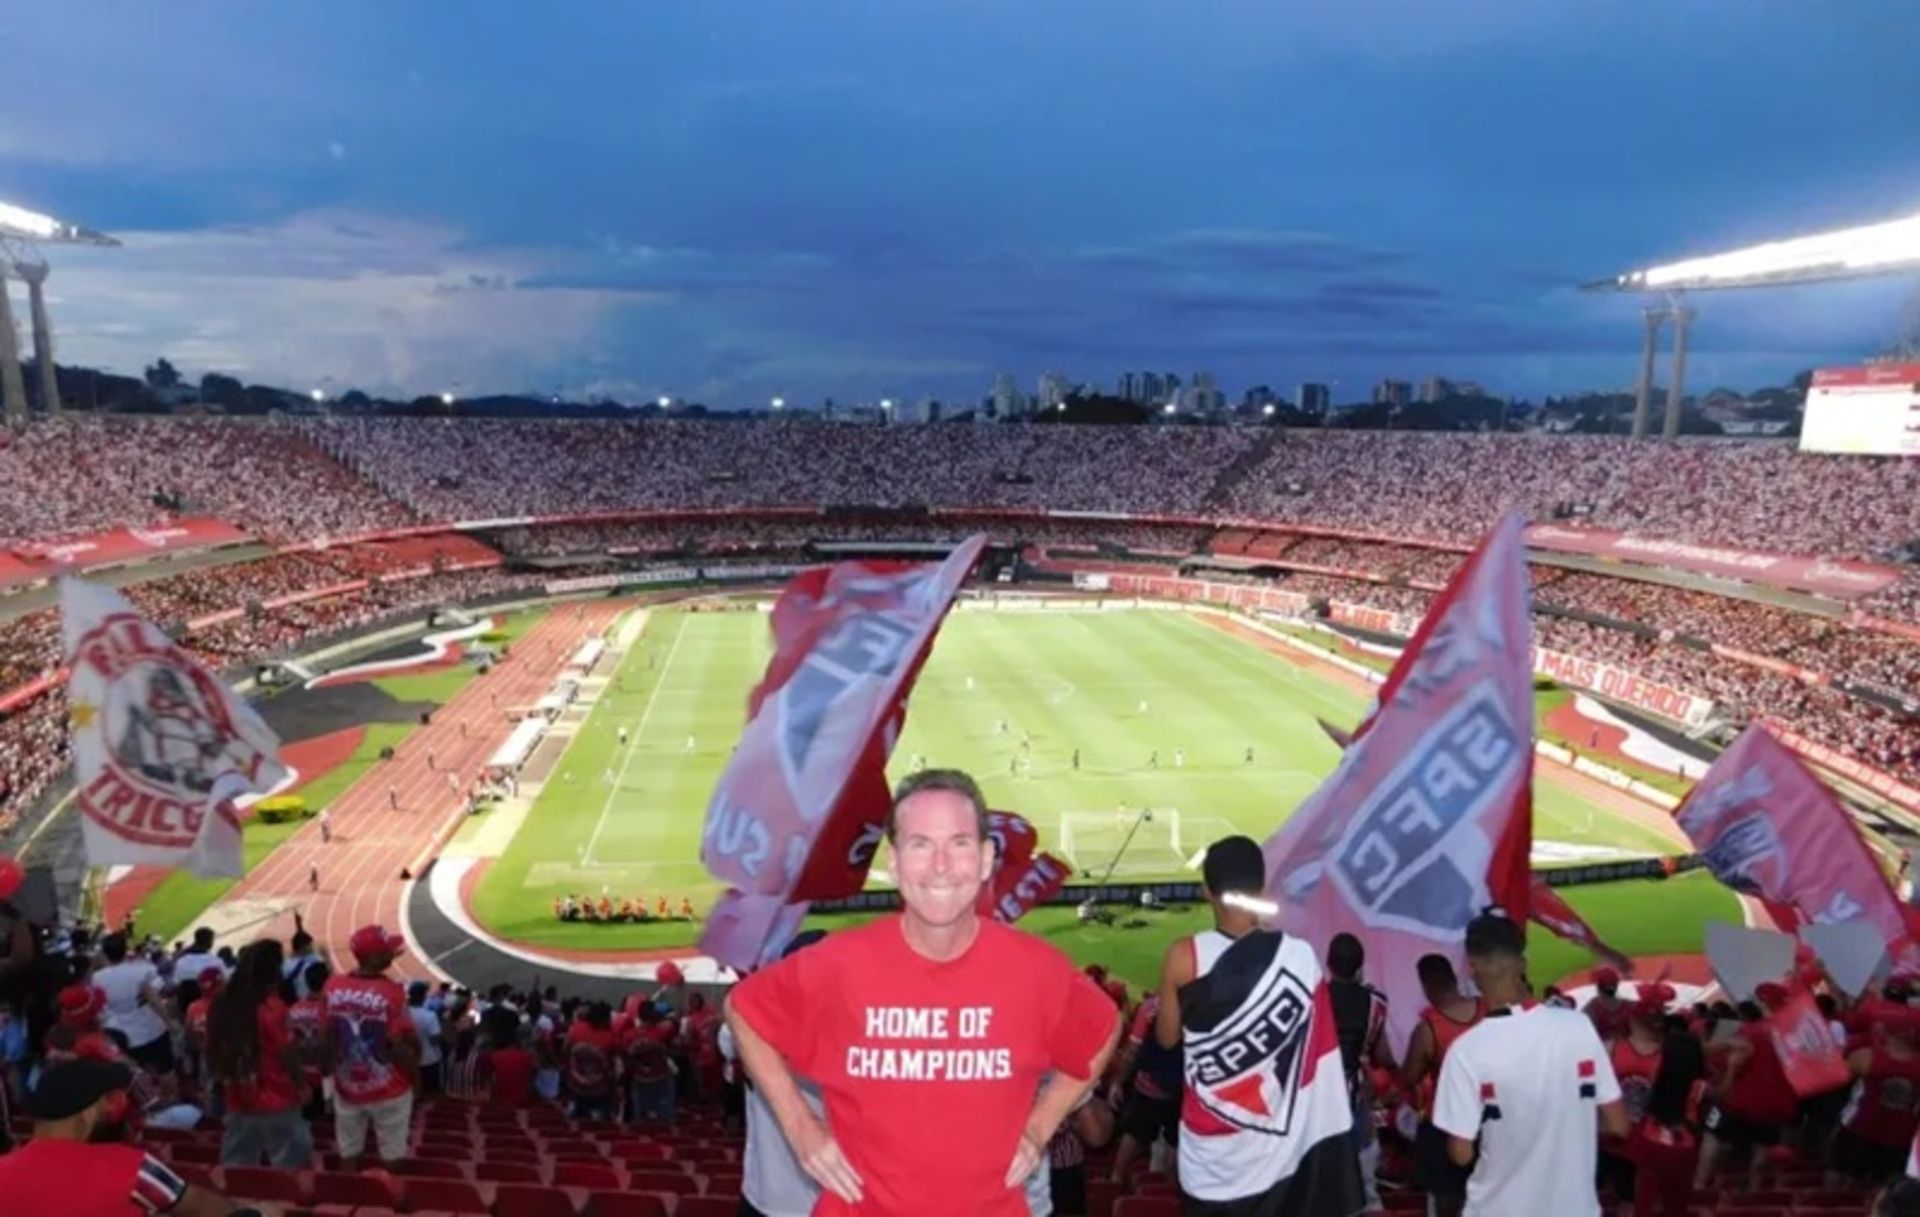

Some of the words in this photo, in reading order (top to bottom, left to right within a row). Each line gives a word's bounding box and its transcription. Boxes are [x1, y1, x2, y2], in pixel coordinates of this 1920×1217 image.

[1542, 652, 1594, 687] MAIS
[1600, 668, 1692, 718] QUERIDO
[865, 1006, 949, 1038] HOME
[959, 1006, 993, 1038] OF
[1198, 997, 1299, 1081] SPFC
